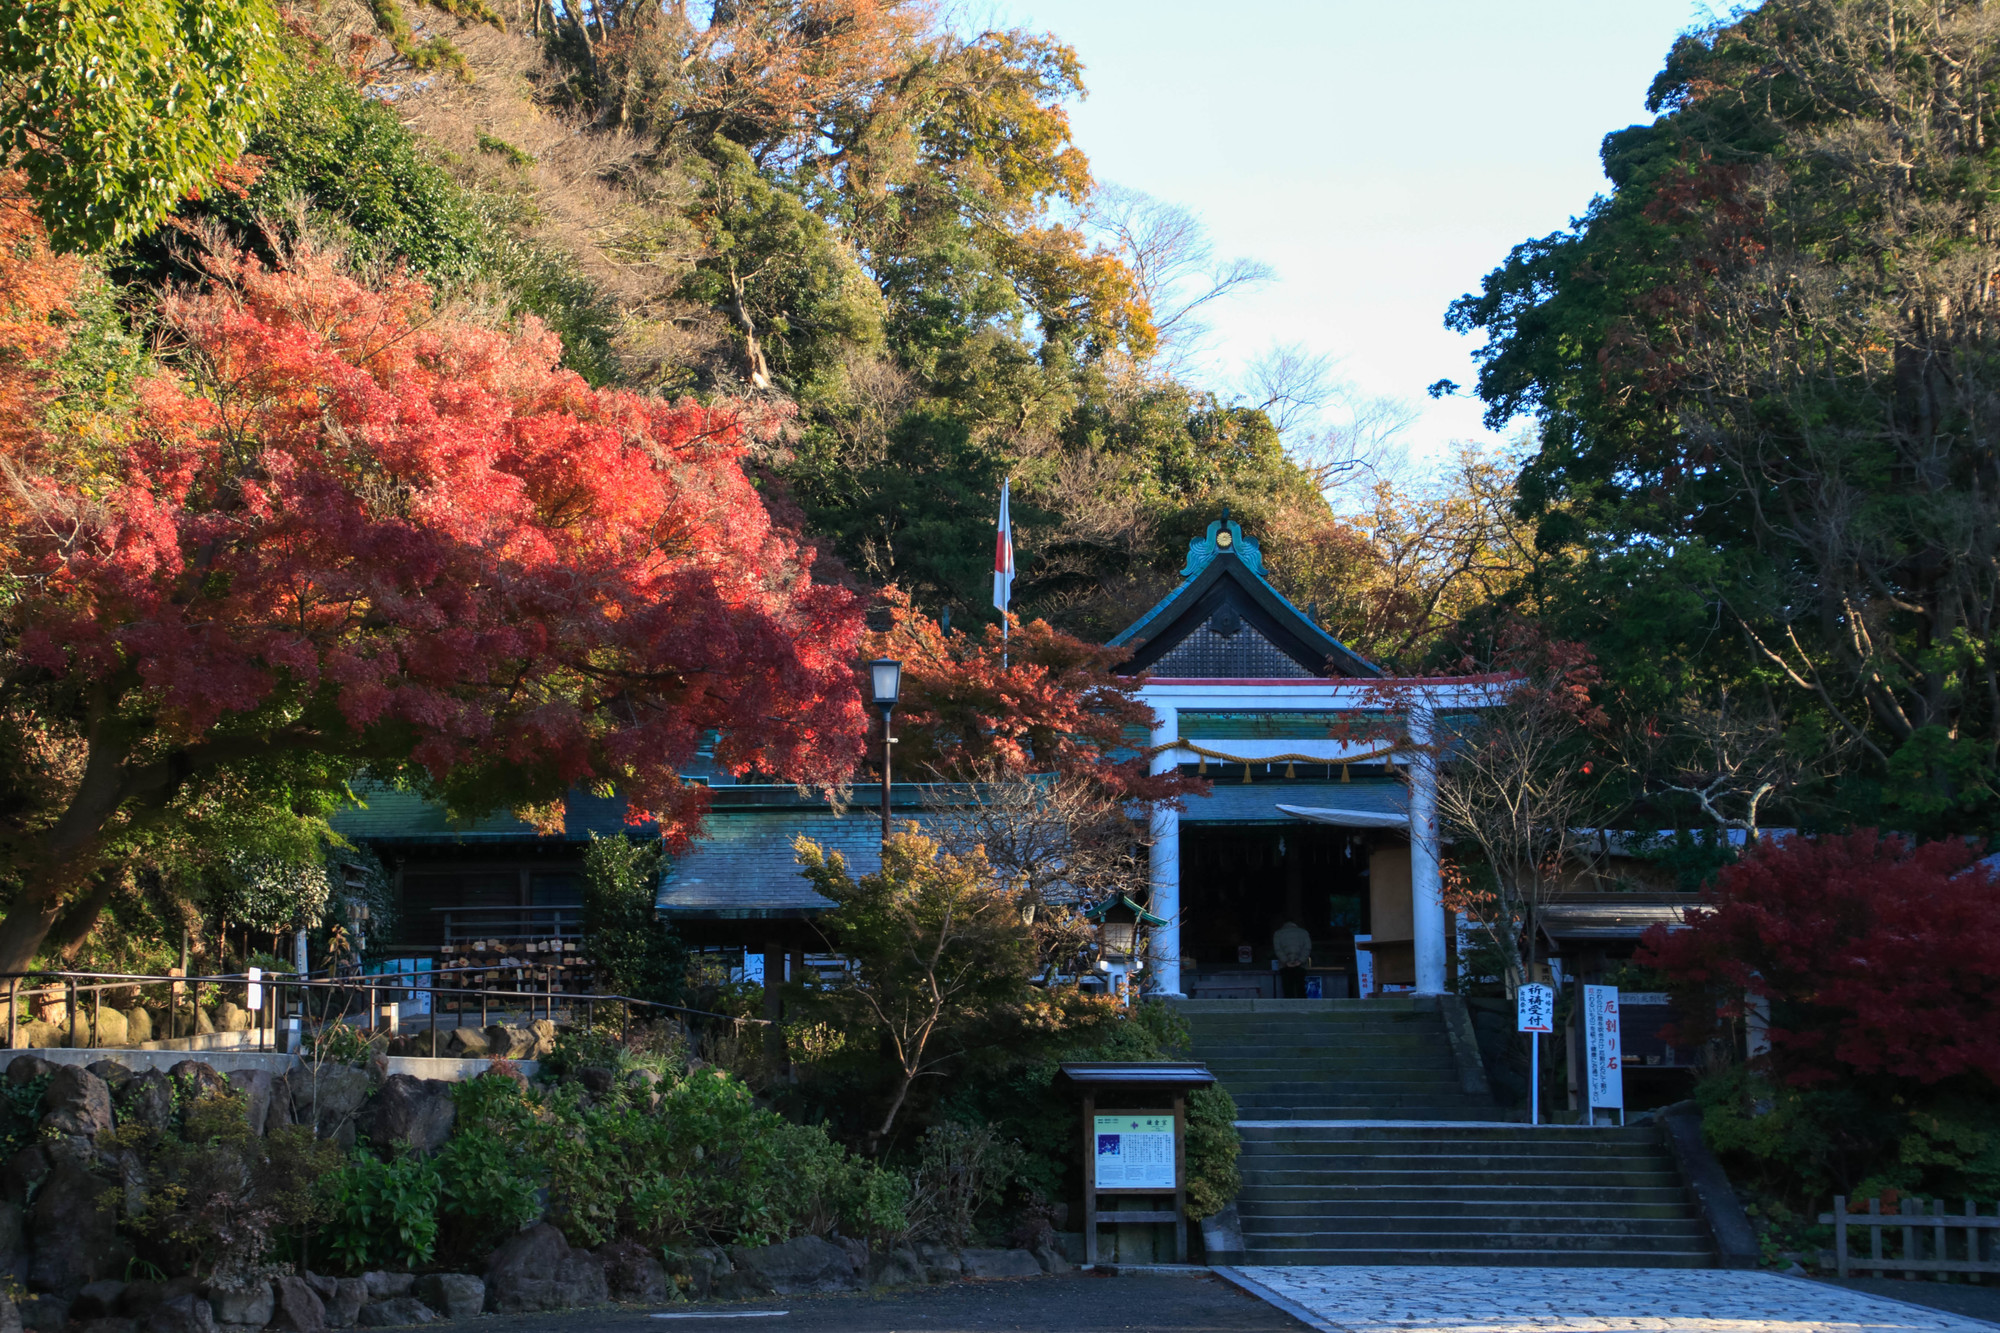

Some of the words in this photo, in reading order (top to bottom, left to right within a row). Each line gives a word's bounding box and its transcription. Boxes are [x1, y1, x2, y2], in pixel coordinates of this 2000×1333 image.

[754, 956, 764, 974] 入口
[1528, 984, 1544, 1026] 祈祷受付
[1604, 1000, 1618, 1070] 厄割り石
